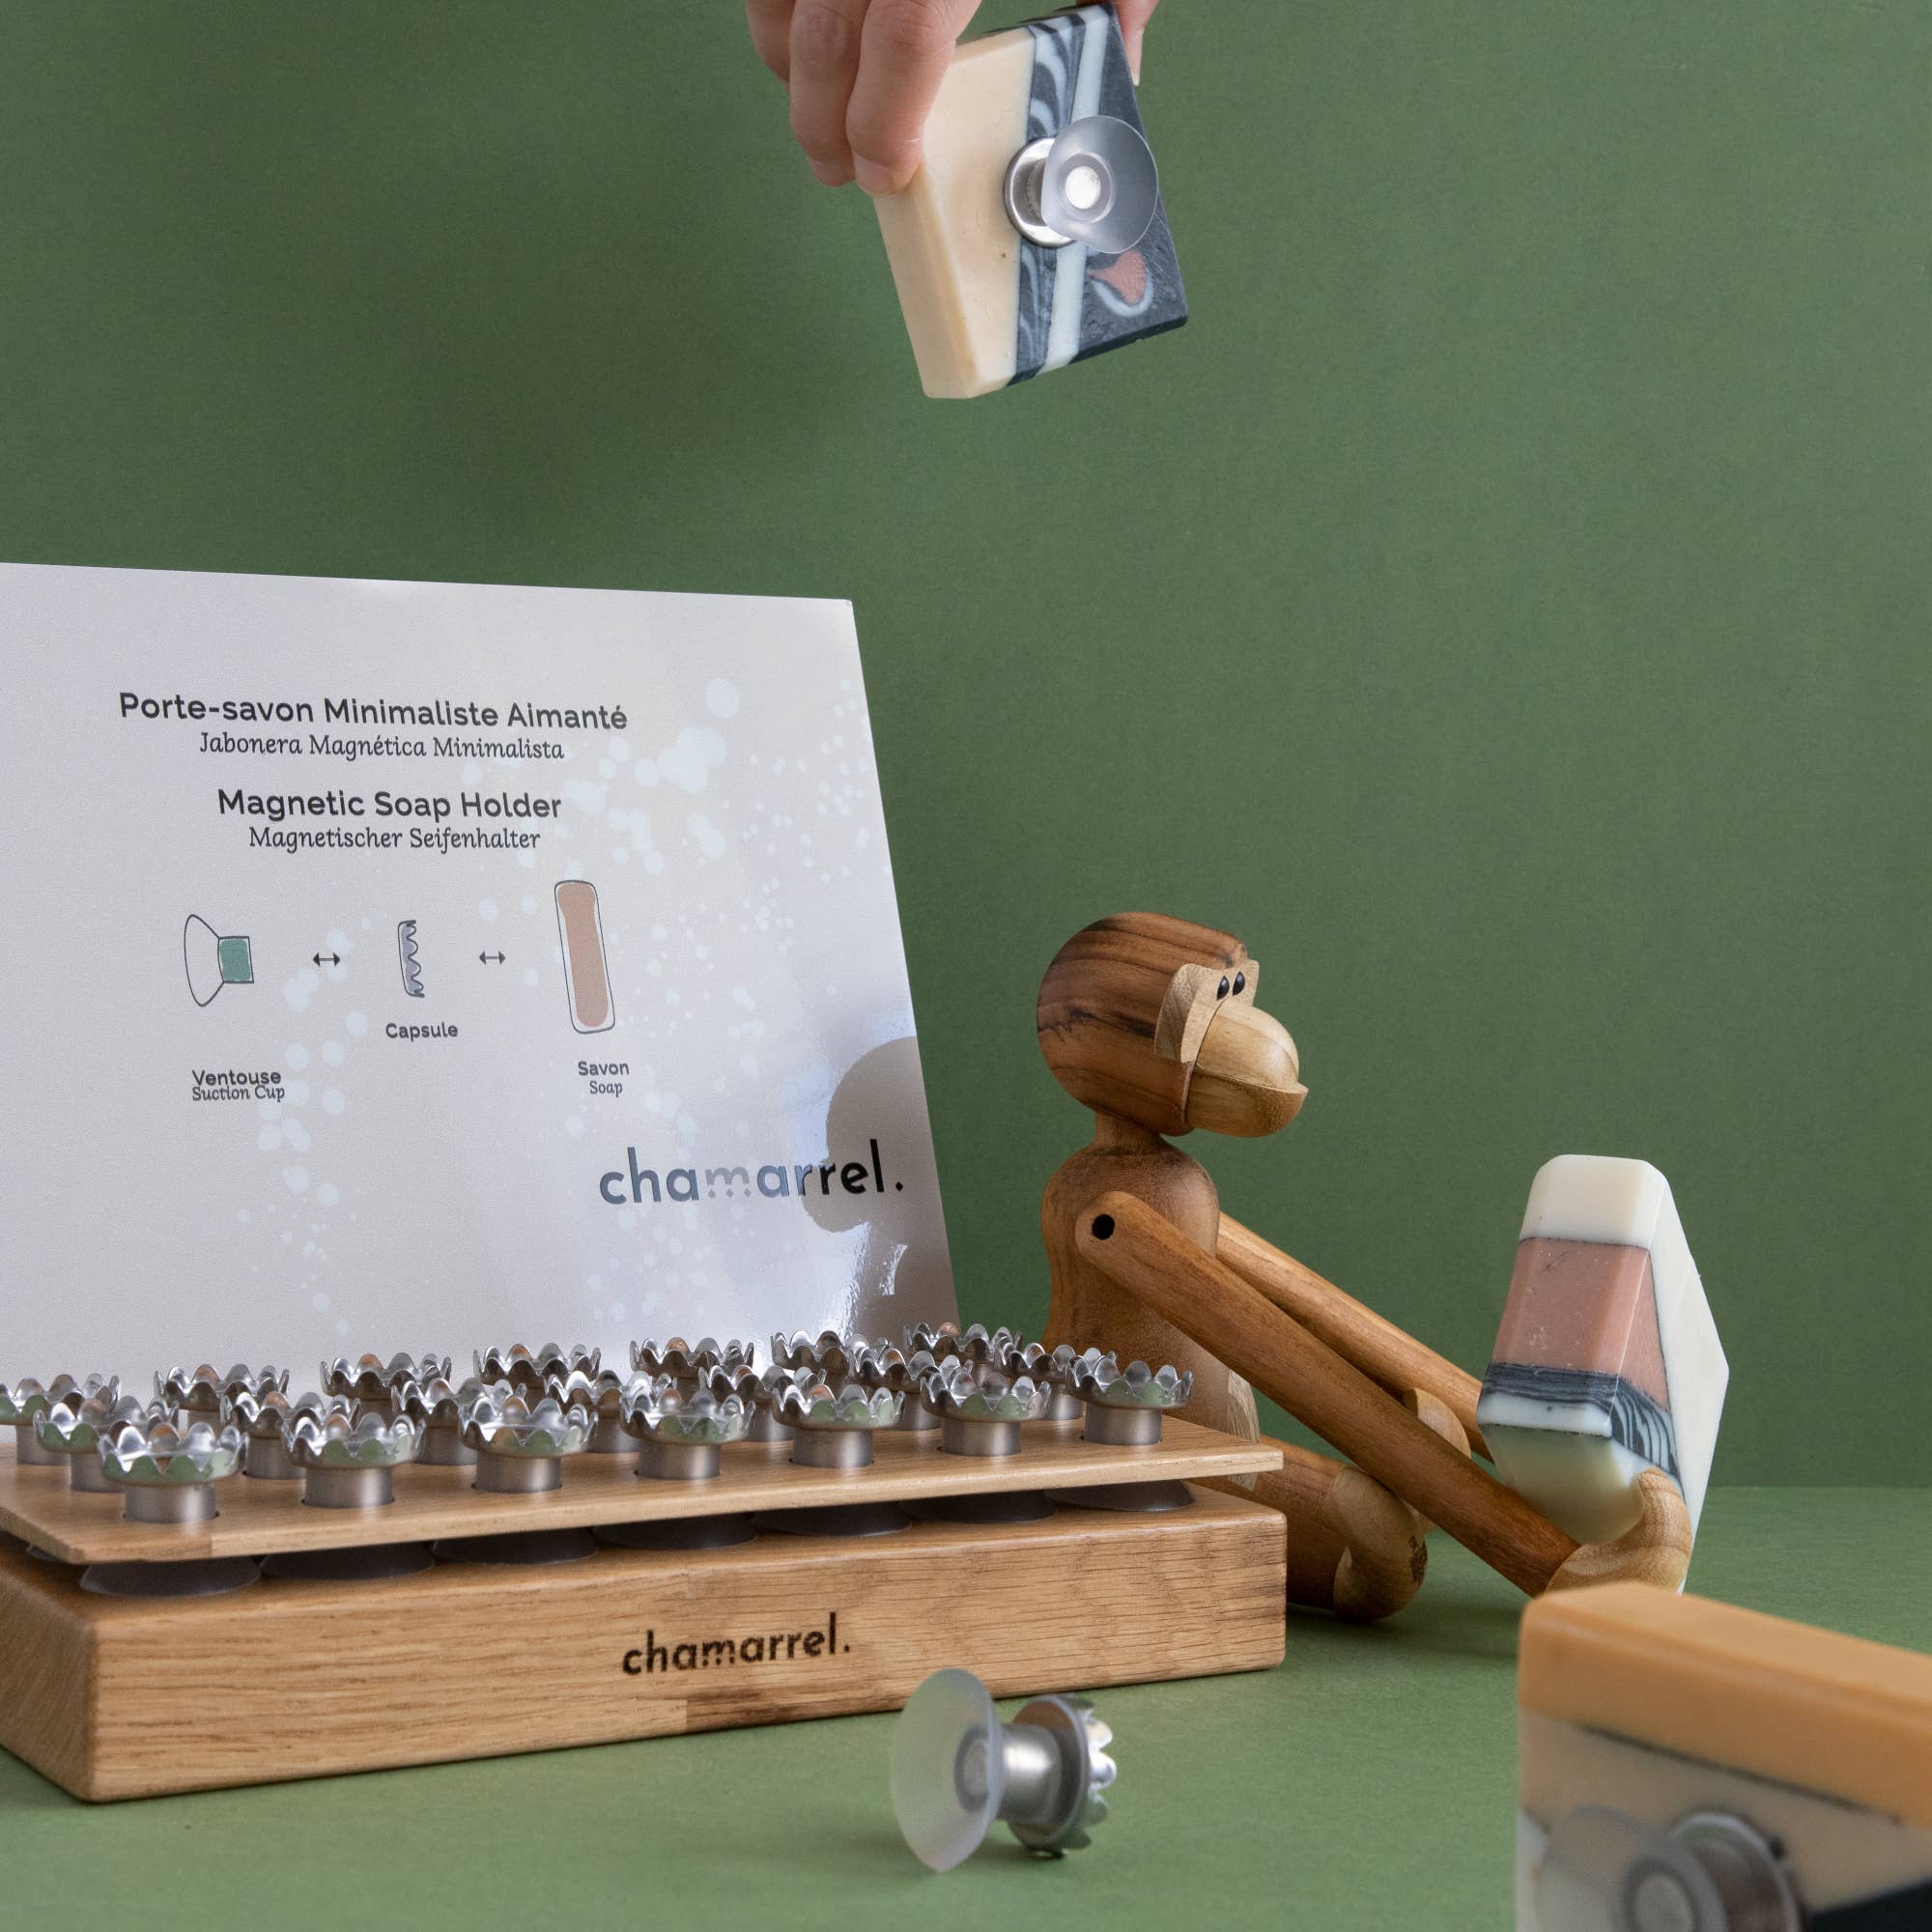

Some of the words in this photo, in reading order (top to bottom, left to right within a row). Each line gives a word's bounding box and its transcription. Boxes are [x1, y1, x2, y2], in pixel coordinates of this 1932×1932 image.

[120, 692, 314, 723] Porte-savon
[324, 697, 498, 727] Minimaliste
[507, 702, 628, 730] Aimanté
[199, 731, 303, 755] Jabonera
[309, 734, 427, 761] Magnética
[433, 737, 565, 759] Minimalista
[217, 788, 365, 822] Magnetic
[374, 790, 451, 822] Soap
[462, 791, 562, 819] Holder
[249, 826, 403, 853] Magnetischer
[410, 827, 541, 854] Seifenhalter
[385, 1022, 459, 1042] Capsule
[191, 1068, 281, 1087] Ventouse
[578, 1060, 630, 1076] Savon
[191, 1085, 251, 1101] Suction
[254, 1084, 286, 1103] Cup
[589, 1080, 623, 1096] Soap
